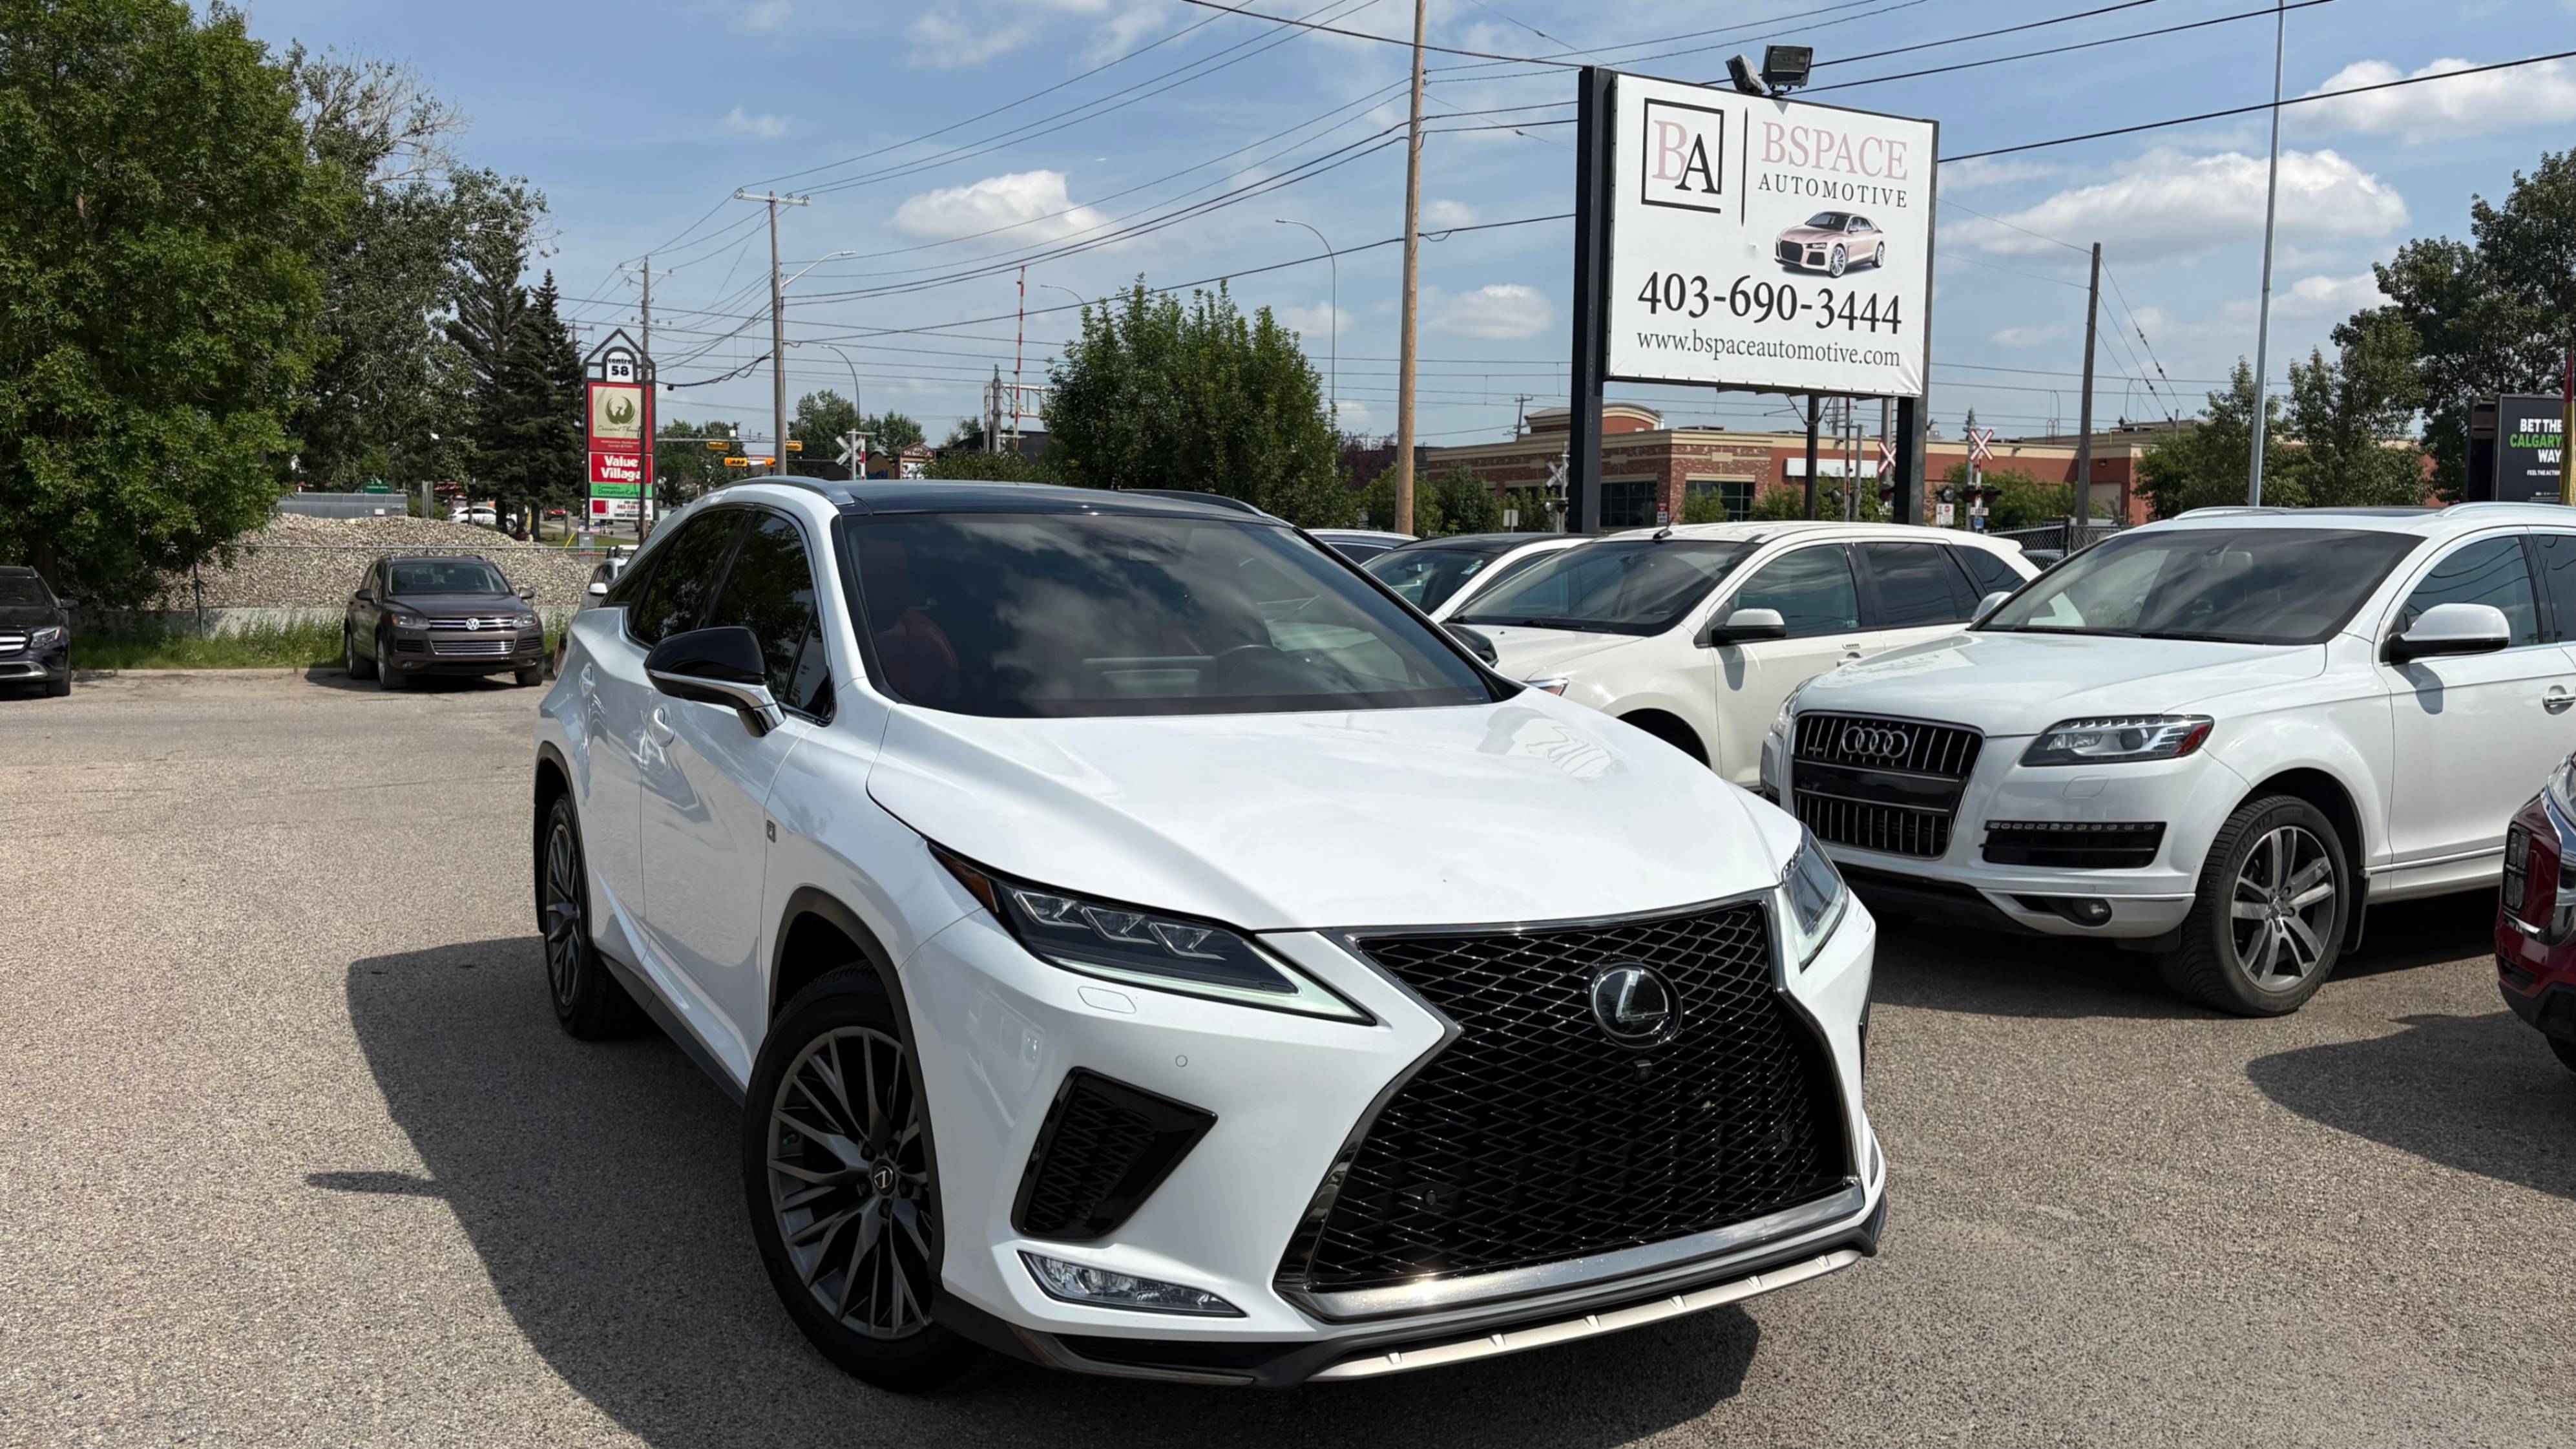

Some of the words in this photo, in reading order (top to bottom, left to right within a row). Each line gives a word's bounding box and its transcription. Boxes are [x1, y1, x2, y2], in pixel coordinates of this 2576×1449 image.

[1652, 120, 1722, 195] BA
[1761, 122, 1908, 181] BSPACE
[1758, 173, 1907, 208] AUTOMOTIVE
[1637, 271, 1902, 335] 403-690-3444
[1637, 329, 1901, 367] www.bspaceautomotive.com
[611, 365, 629, 376] 58
[2520, 418, 2542, 432] BET
[2542, 419, 2562, 433] THE
[2509, 434, 2562, 448] CALGARY
[604, 455, 638, 467] Value
[2538, 449, 2562, 463] WAY
